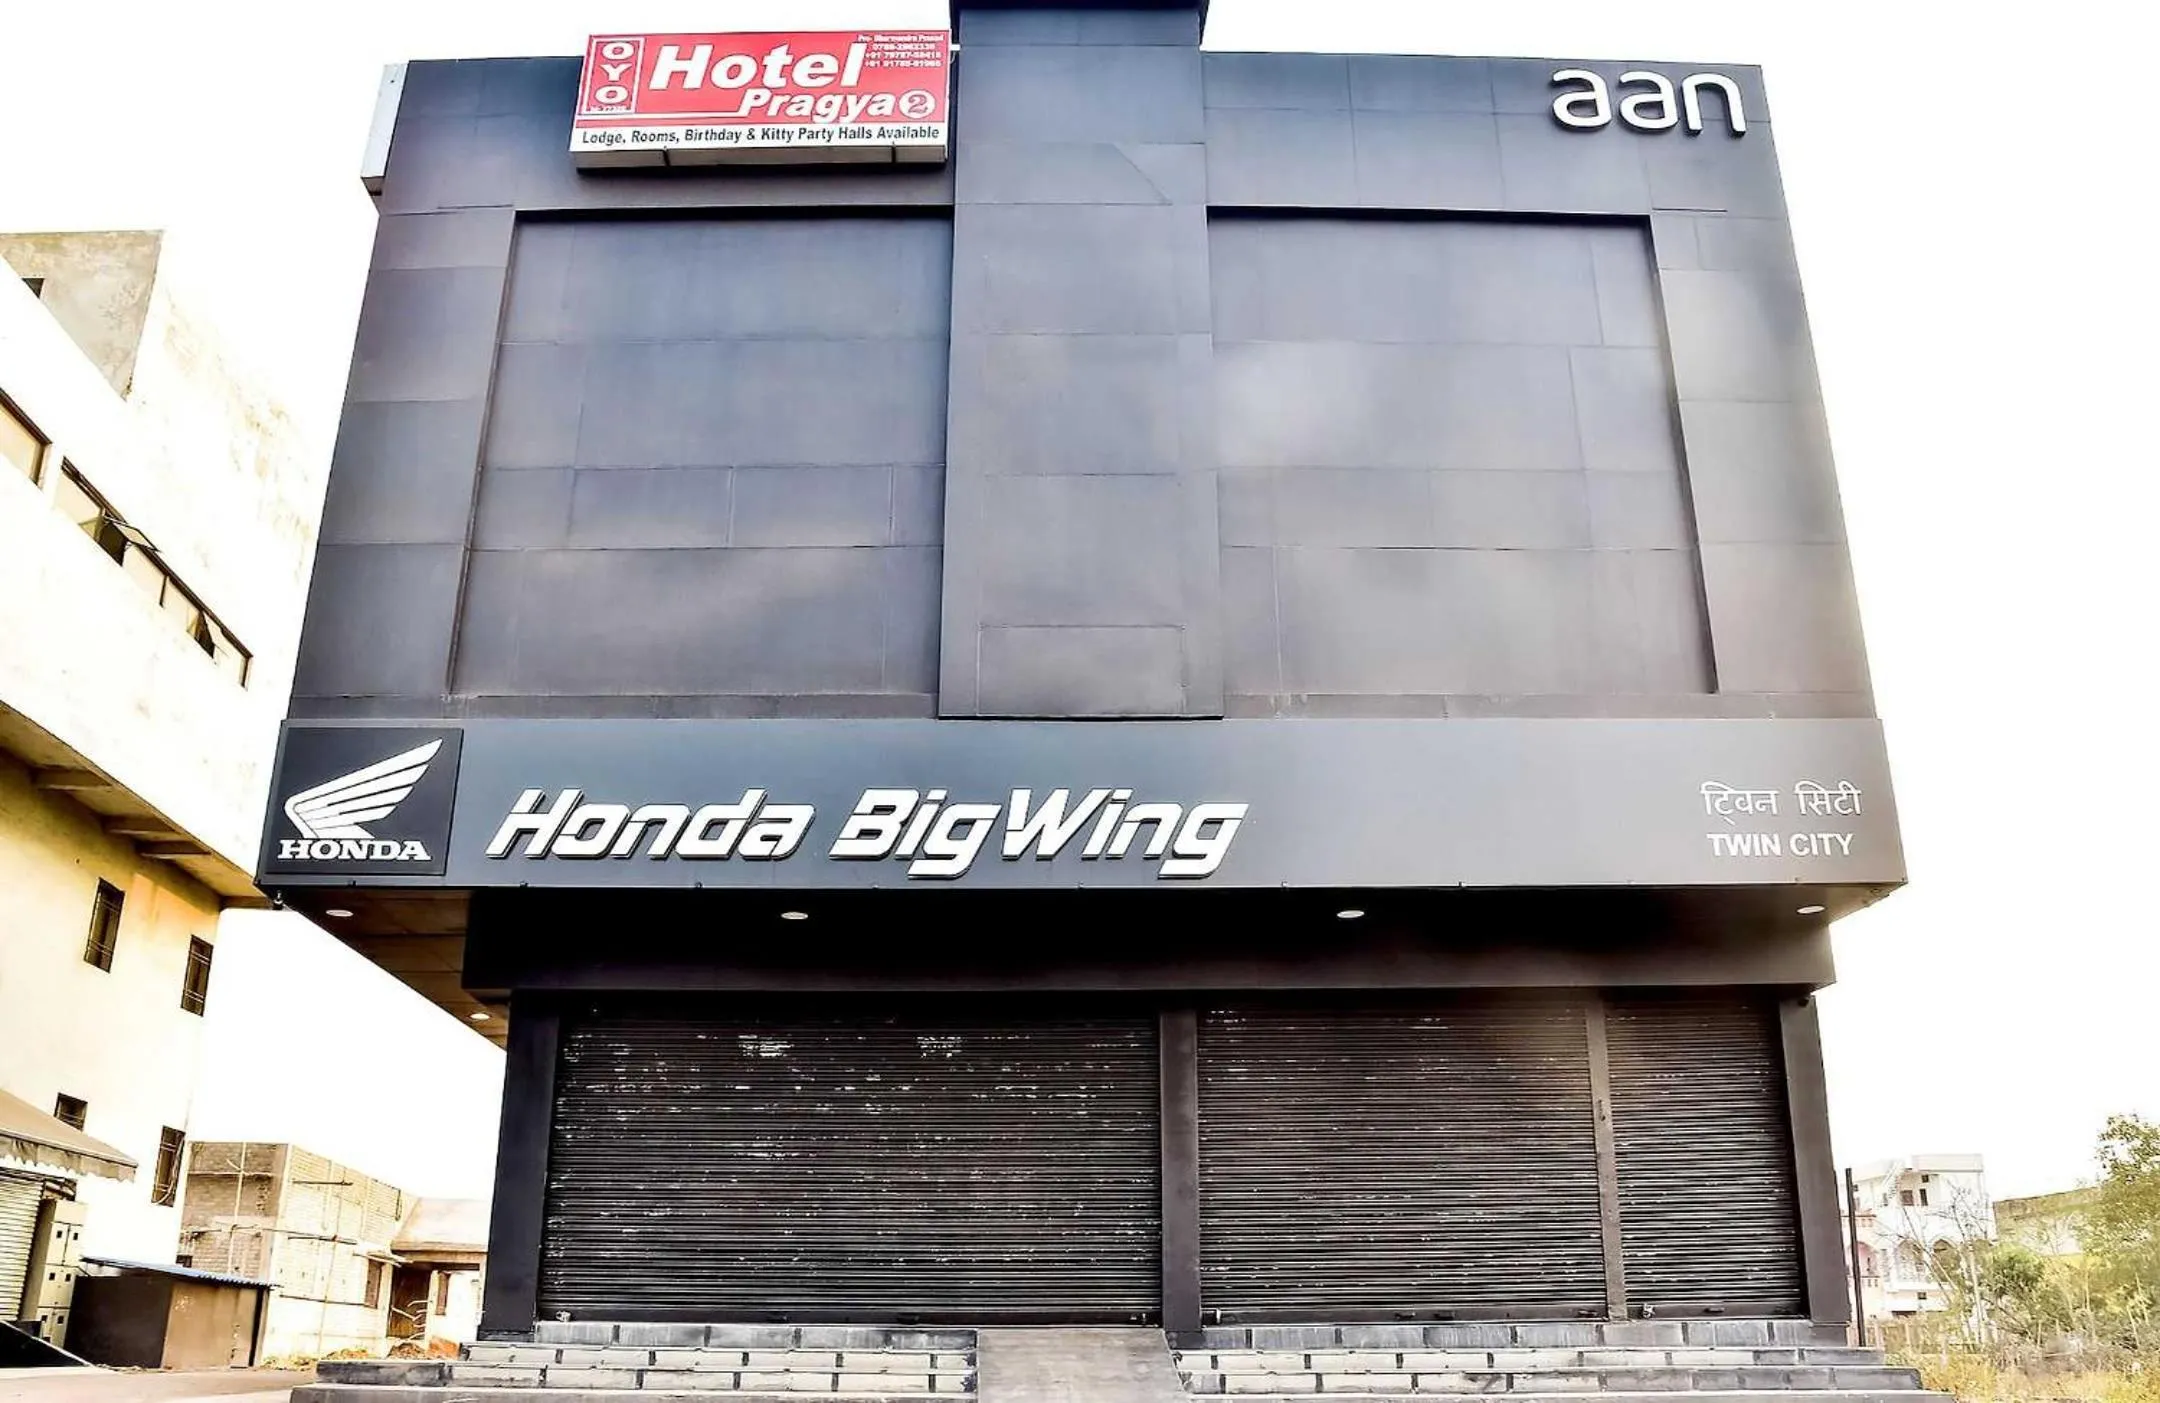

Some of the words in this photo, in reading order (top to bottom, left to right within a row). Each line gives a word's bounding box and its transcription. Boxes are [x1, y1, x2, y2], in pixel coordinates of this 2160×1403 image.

[595, 42, 634, 105] OYO
[648, 41, 868, 90] Hotel
[738, 88, 899, 125] Pragya
[903, 91, 932, 116] 2
[1549, 68, 1748, 135] aan
[582, 130, 626, 146] Lodge,
[631, 129, 680, 144] Rooms,
[685, 128, 742, 142] Birthday
[747, 128, 757, 140] &
[761, 127, 795, 143] Kitty
[798, 127, 835, 143] Party
[838, 126, 873, 140] Halls
[877, 126, 940, 140] Available
[1794, 780, 1863, 816] सिटी
[485, 787, 817, 861] Honda
[277, 839, 432, 861] HONDA
[1706, 833, 1783, 857] TWIN
[1789, 833, 1855, 857] CITY
